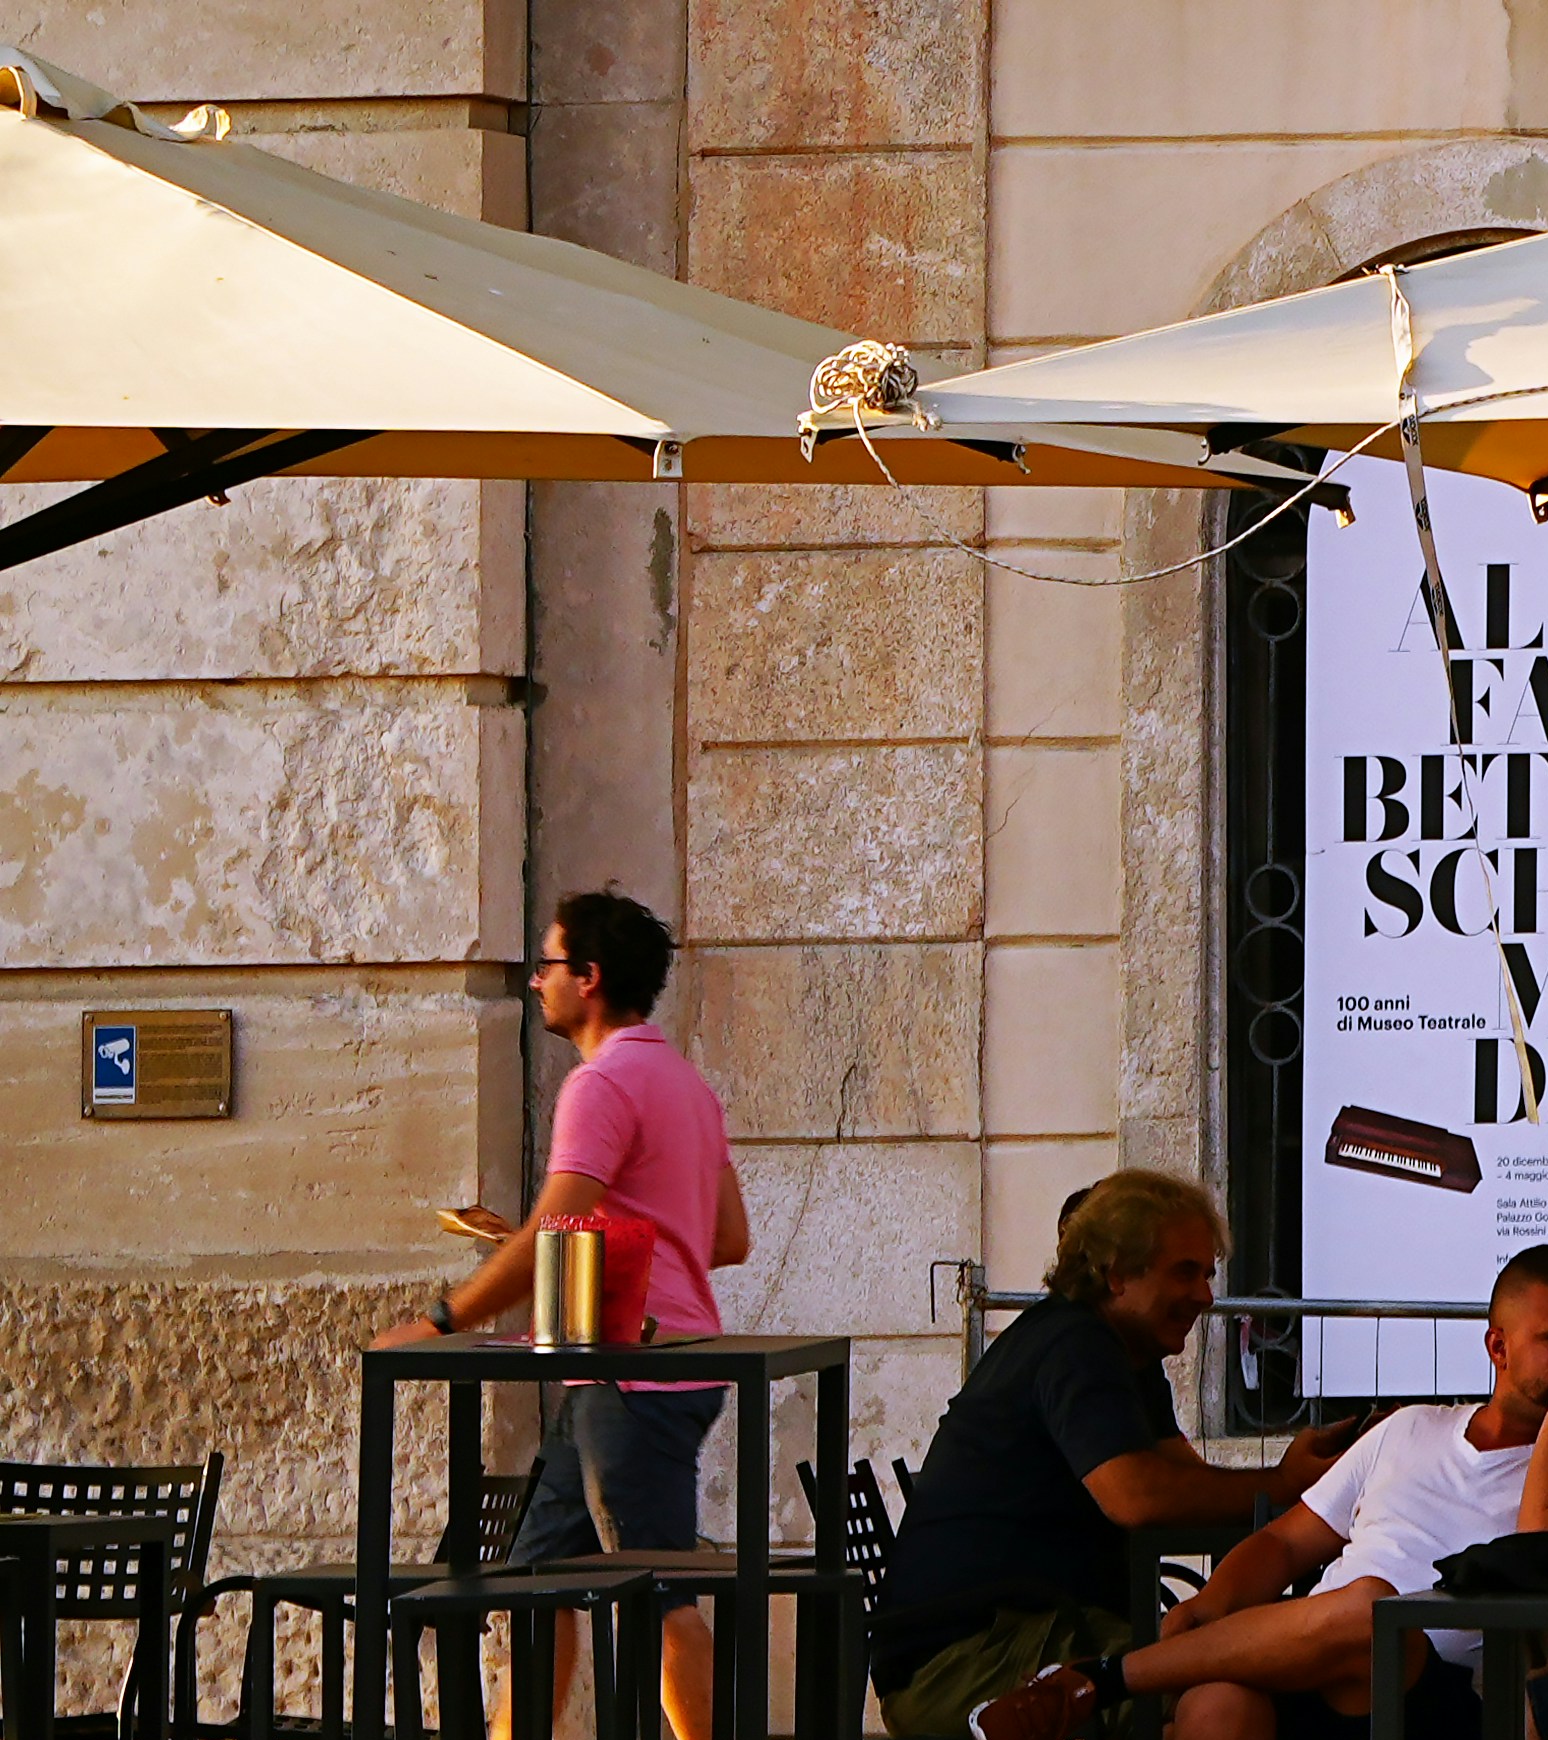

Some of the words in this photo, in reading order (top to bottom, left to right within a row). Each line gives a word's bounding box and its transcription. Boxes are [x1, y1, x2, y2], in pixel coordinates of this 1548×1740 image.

[1336, 994, 1370, 1012] 100
[1373, 993, 1410, 1012] anni
[1336, 1014, 1353, 1032] di
[1356, 1015, 1414, 1032] Museo
[1417, 1012, 1487, 1031] Teatrale
[1496, 1156, 1510, 1168] 20
[1496, 1197, 1517, 1209] Sala
[1496, 1211, 1532, 1223] Palazzo
[1496, 1225, 1510, 1237] via
[1512, 1225, 1546, 1237] Rossini
